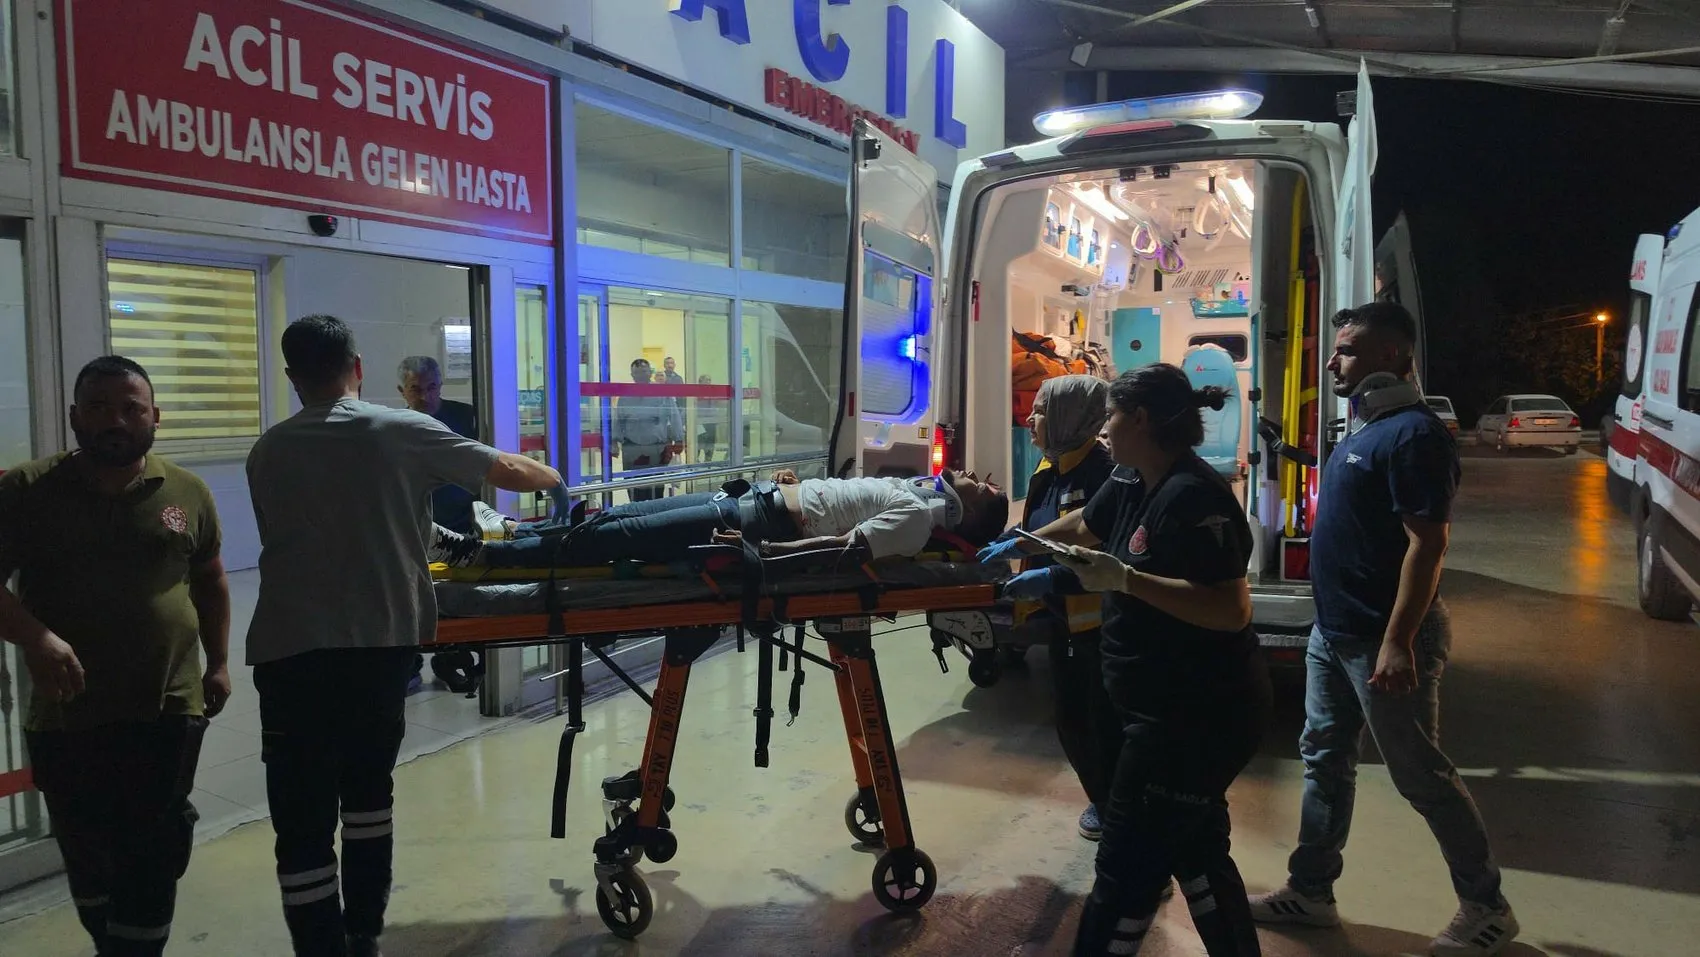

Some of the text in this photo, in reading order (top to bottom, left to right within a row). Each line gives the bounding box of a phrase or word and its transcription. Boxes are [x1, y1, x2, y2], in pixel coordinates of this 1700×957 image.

[184, 12, 494, 141] ACİL SERVİS
[765, 68, 920, 154] EMERY
[106, 89, 531, 214] AMBULANSLA GELEN HASTA
